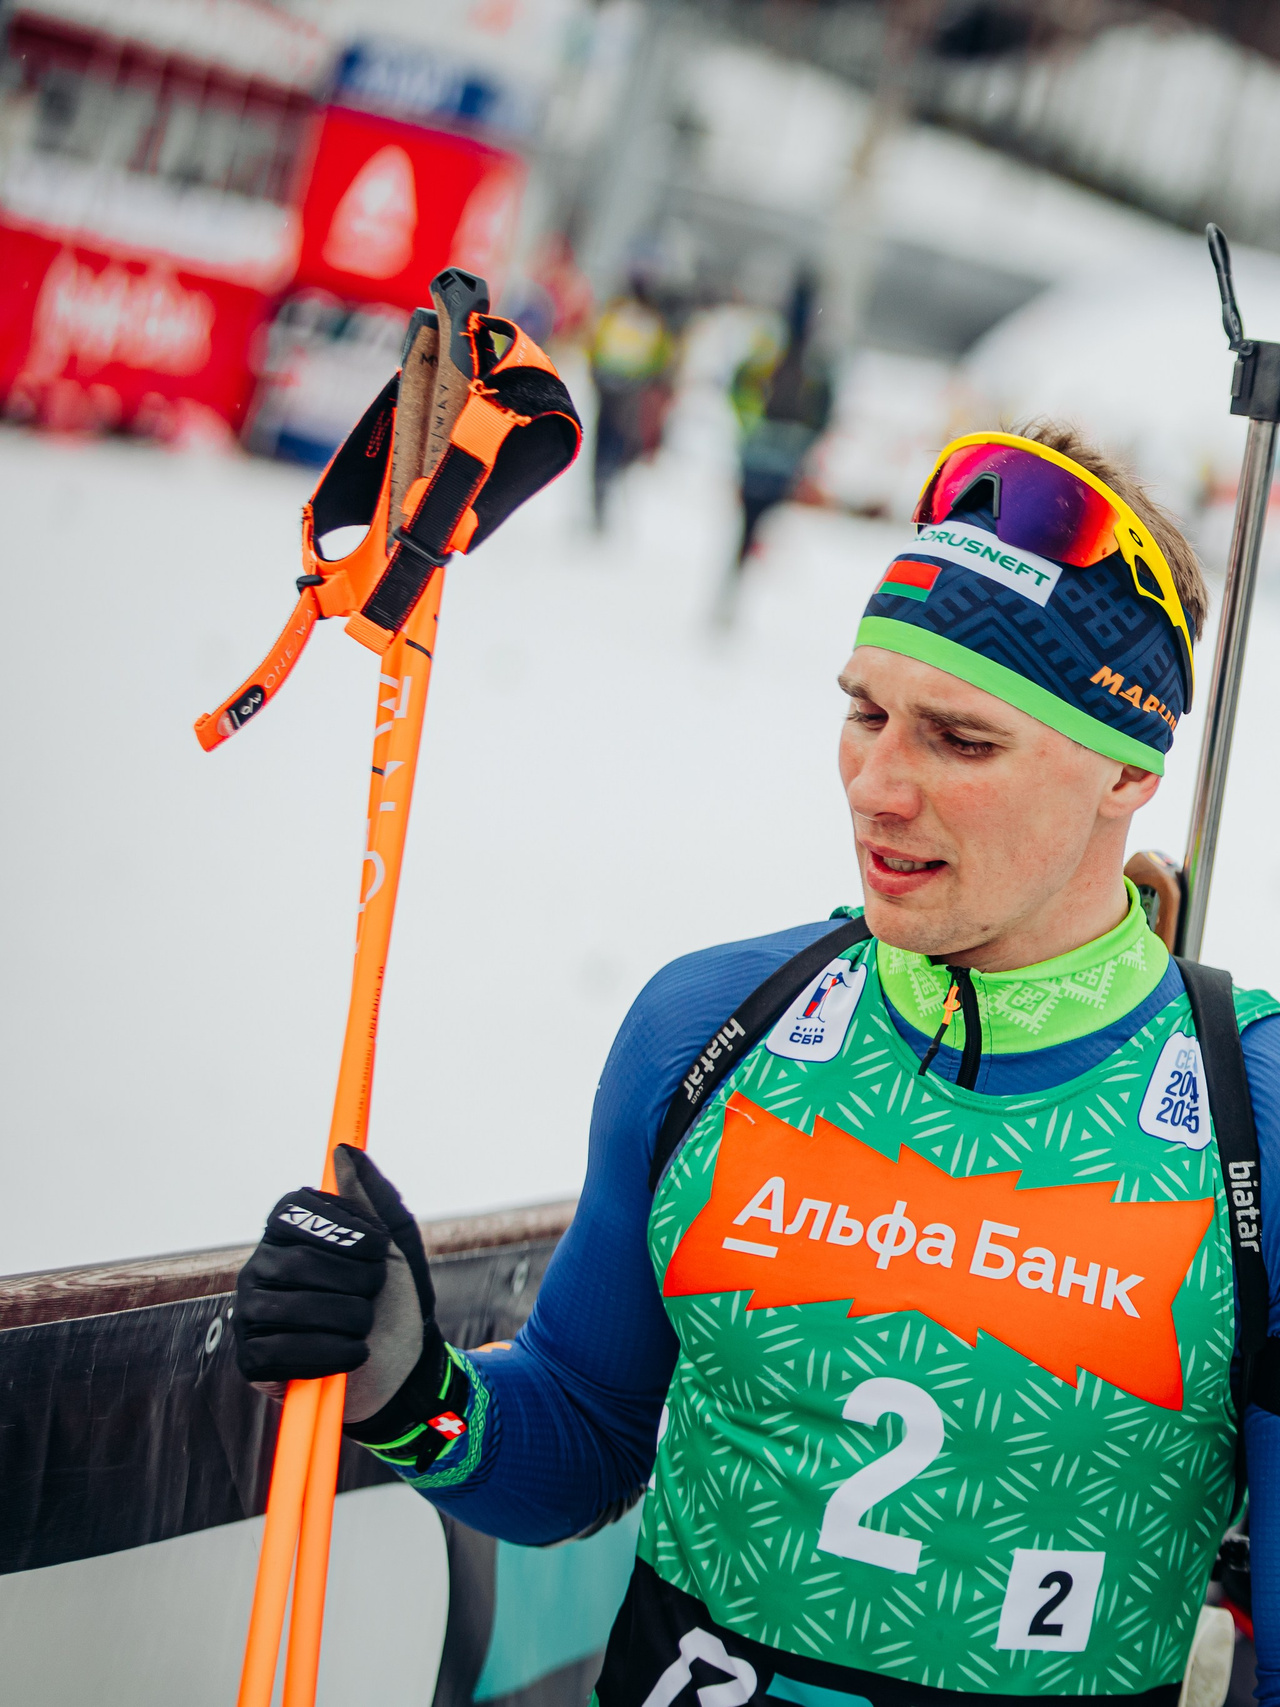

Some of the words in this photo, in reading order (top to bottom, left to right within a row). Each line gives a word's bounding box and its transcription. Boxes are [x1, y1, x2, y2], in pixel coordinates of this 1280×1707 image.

[789, 1031, 824, 1046] СБР
[722, 1177, 957, 1271] Альфа
[969, 1218, 1145, 1320] Банк
[1228, 1160, 1261, 1253] biatar
[817, 1376, 945, 1576] 2
[1027, 1570, 1074, 1637] 2
